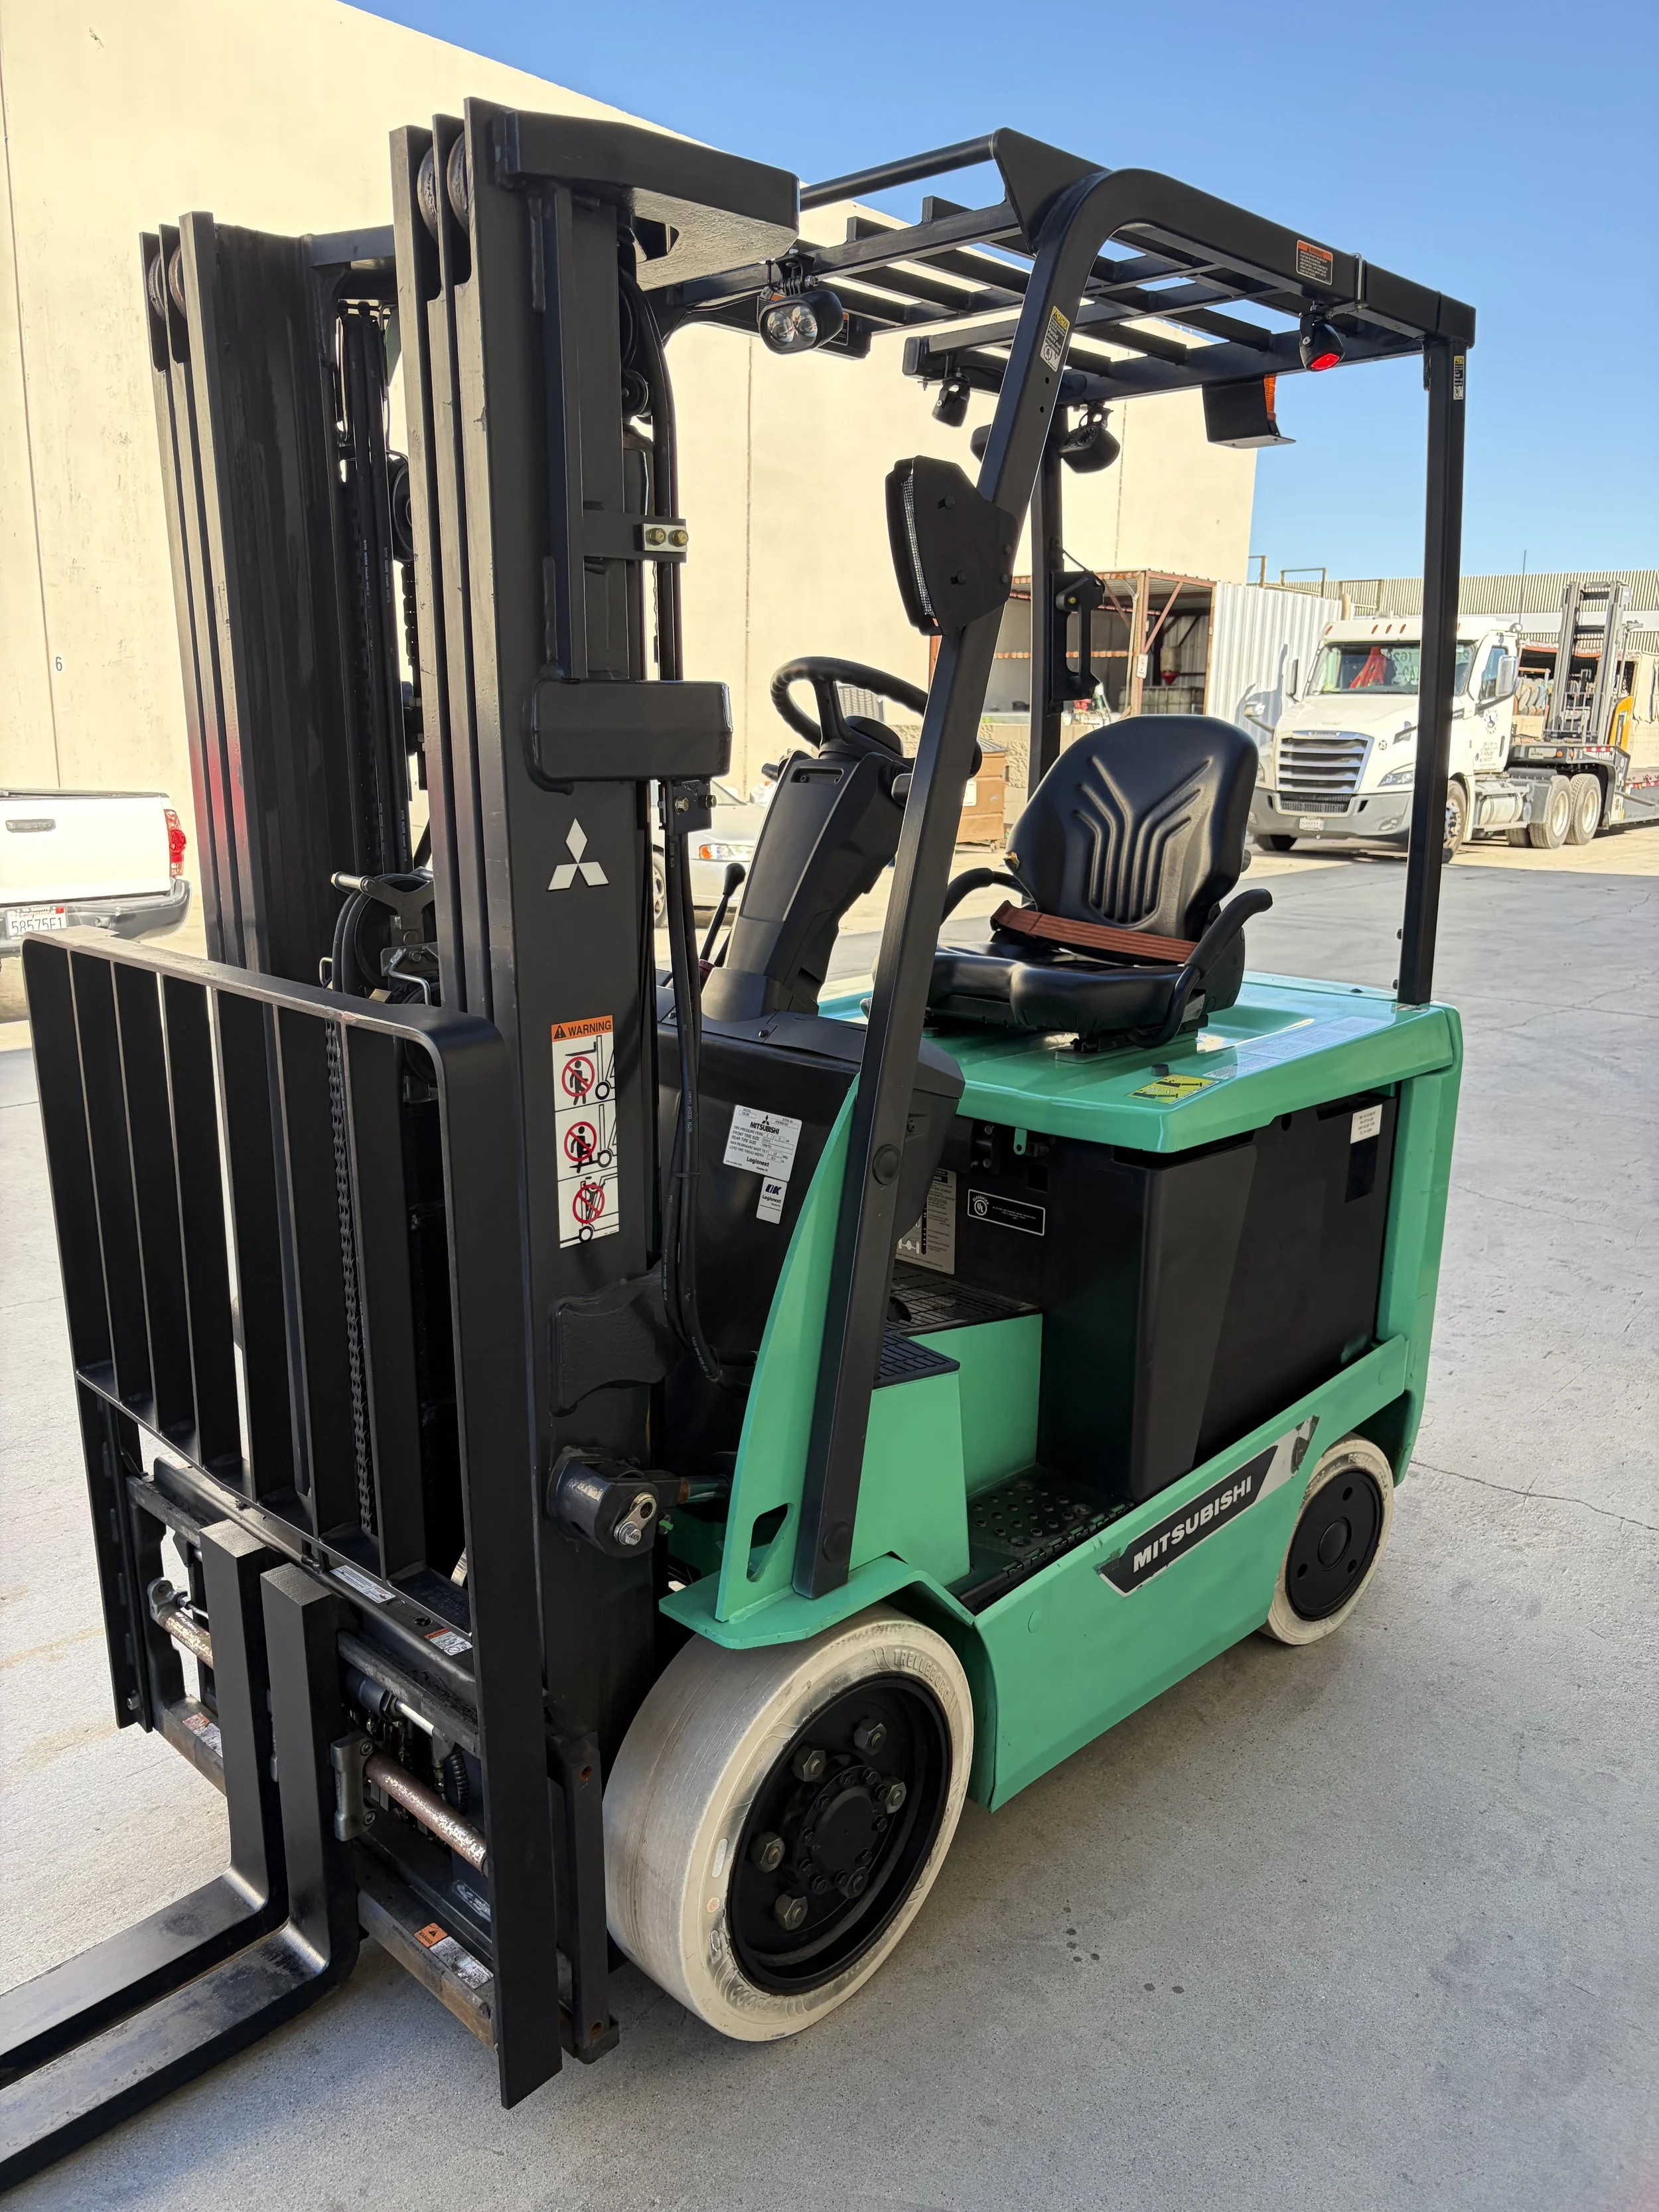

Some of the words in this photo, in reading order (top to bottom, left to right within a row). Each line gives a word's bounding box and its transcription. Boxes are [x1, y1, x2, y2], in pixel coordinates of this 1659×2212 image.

[568, 1020, 612, 1037] WARNING
[750, 1122, 780, 1134] MITSUBISHI
[747, 1156, 769, 1167] Logisnext
[762, 1195, 781, 1203] Logisnext
[1133, 1475, 1252, 1573] MITSUBISHI
[893, 1648, 950, 1702] TRELLEBORG
